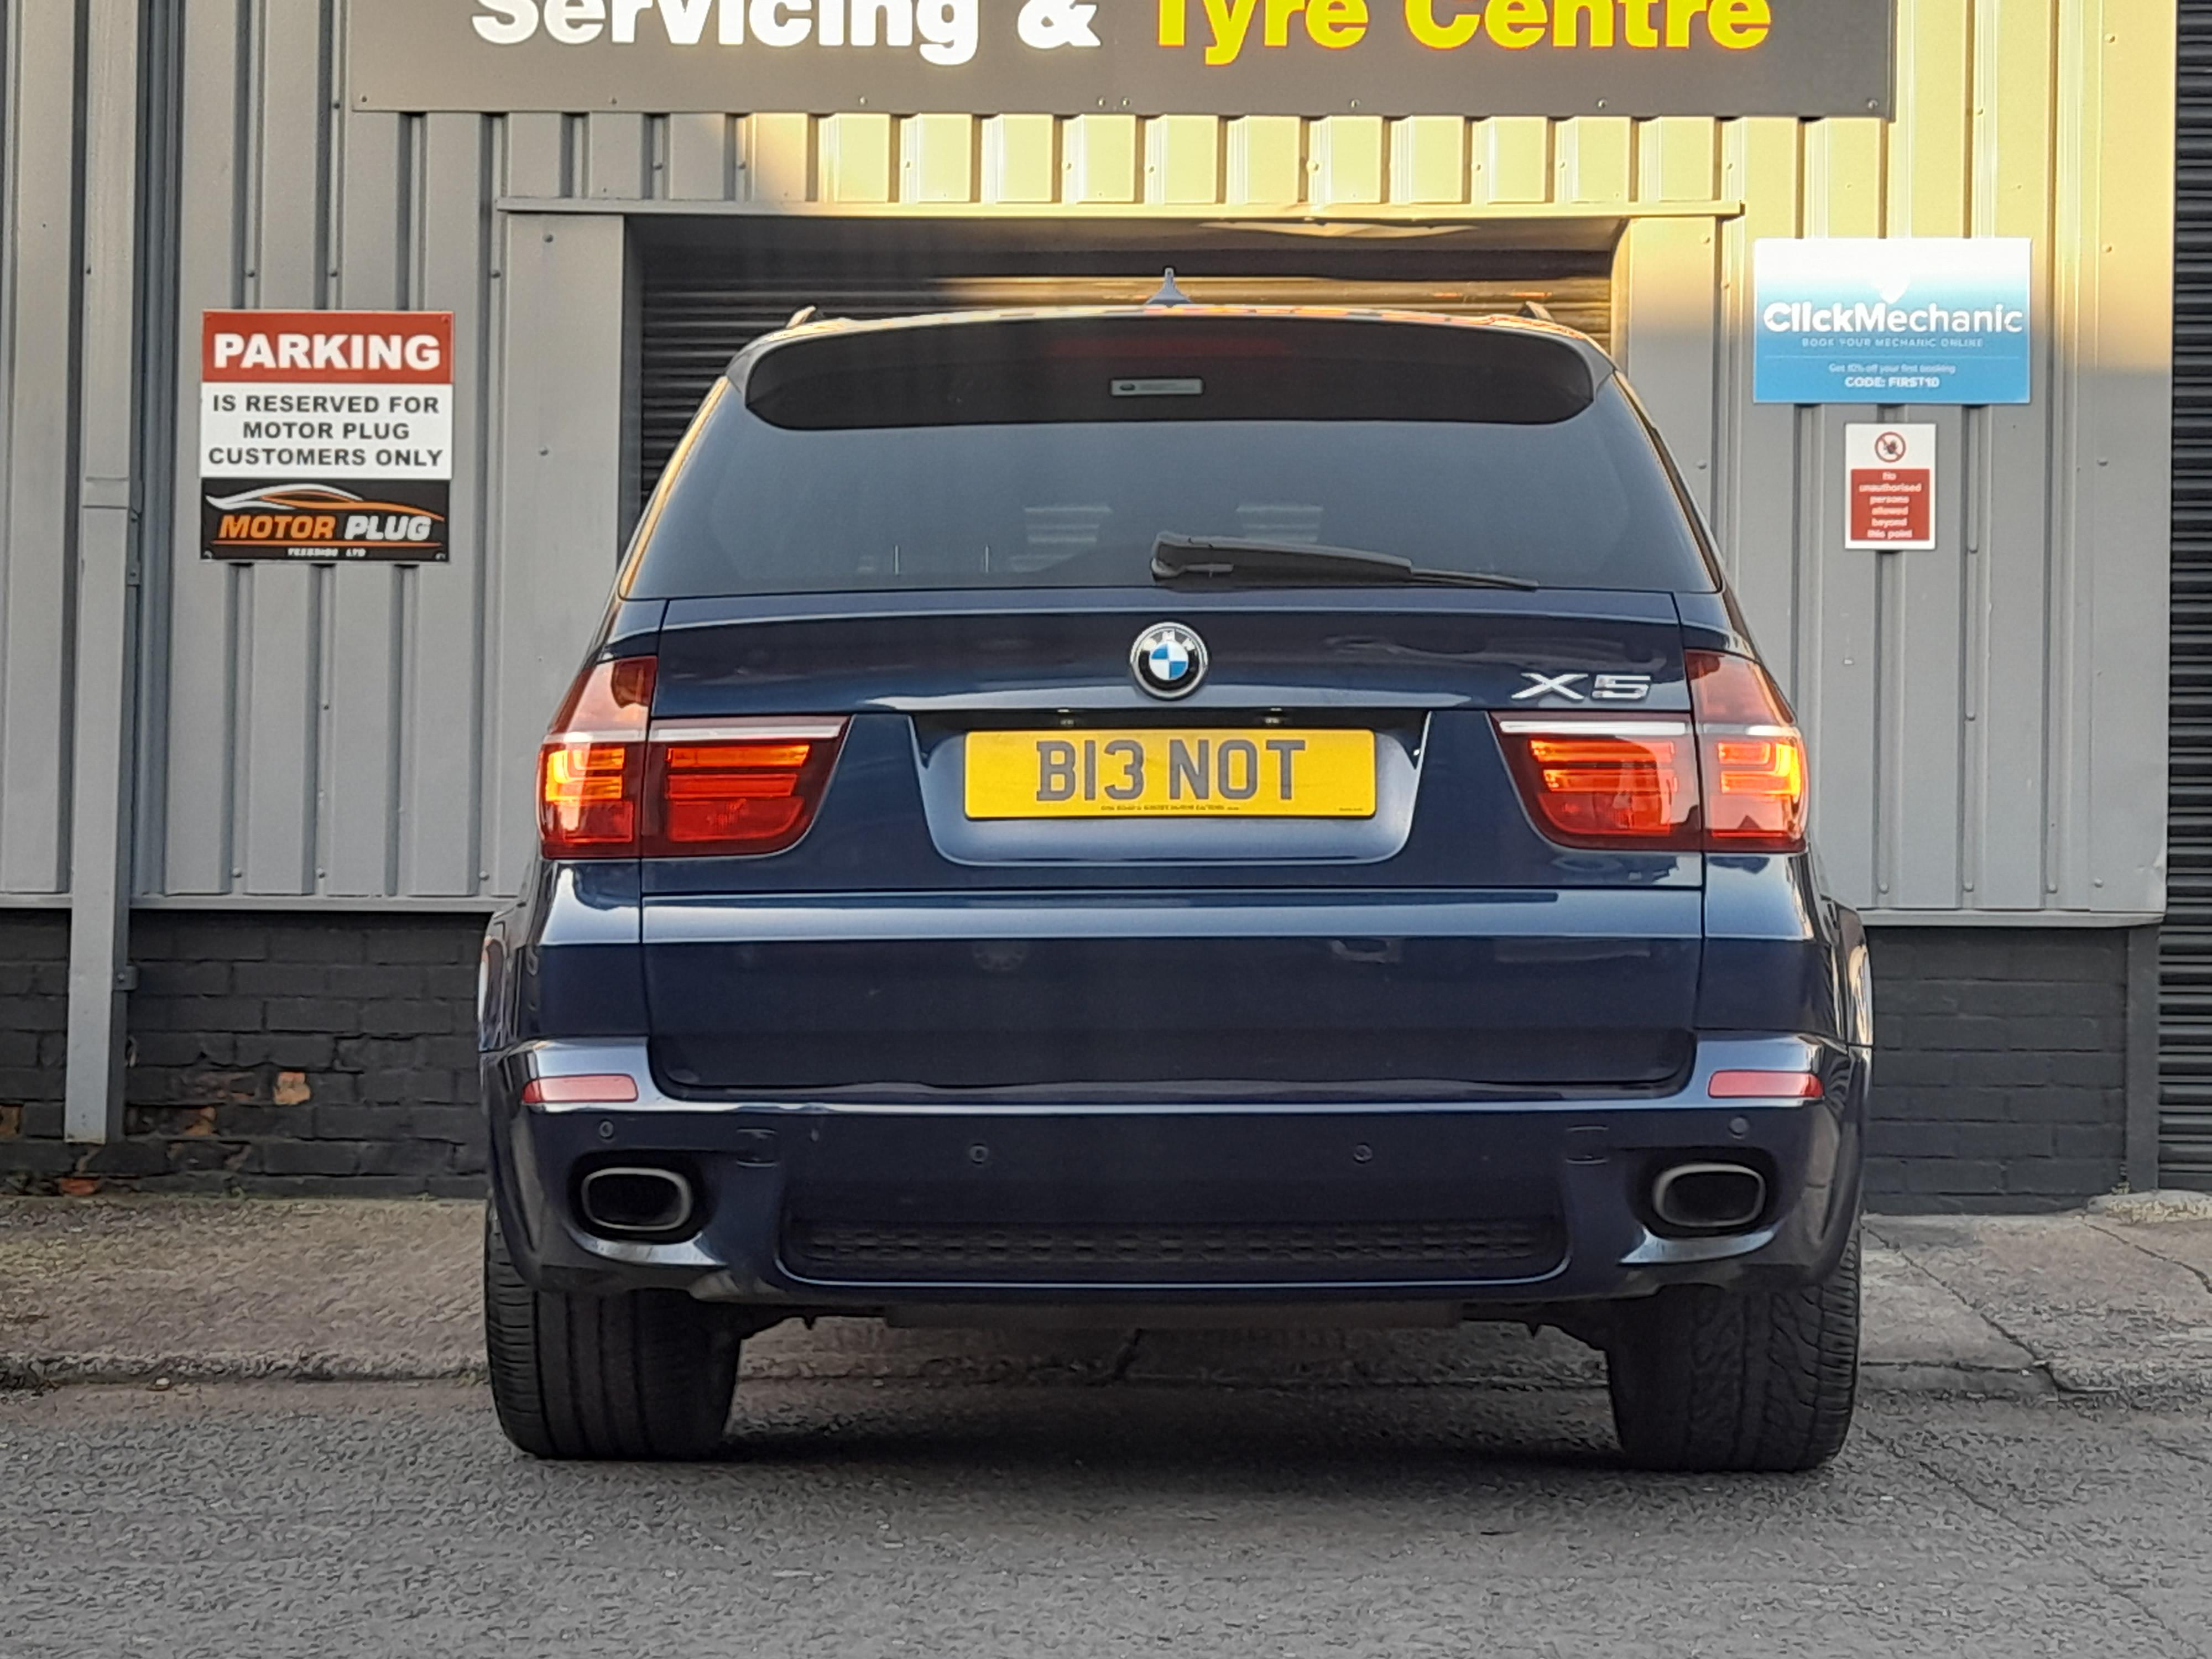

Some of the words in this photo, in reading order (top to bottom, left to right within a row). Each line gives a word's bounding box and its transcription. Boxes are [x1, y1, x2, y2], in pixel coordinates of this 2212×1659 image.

[472, 0, 978, 65] Servicing
[1018, 0, 1101, 49] &
[1405, 0, 1771, 49] Centre
[1763, 302, 2023, 333] ClickMechanic
[213, 333, 441, 371] PARKING
[213, 395, 236, 412] IS
[246, 396, 380, 413] RESERVED
[389, 397, 439, 413] FOR
[243, 422, 333, 439] MOTOR
[343, 422, 410, 440] PLUG
[208, 448, 366, 465] CUSTOMERS
[375, 450, 443, 466] ONLY
[218, 515, 336, 539] MOTOR
[344, 516, 431, 540] PLUG
[1511, 672, 1651, 700] X5
[1036, 739, 1143, 801] B13
[1168, 739, 1305, 800] NOT
